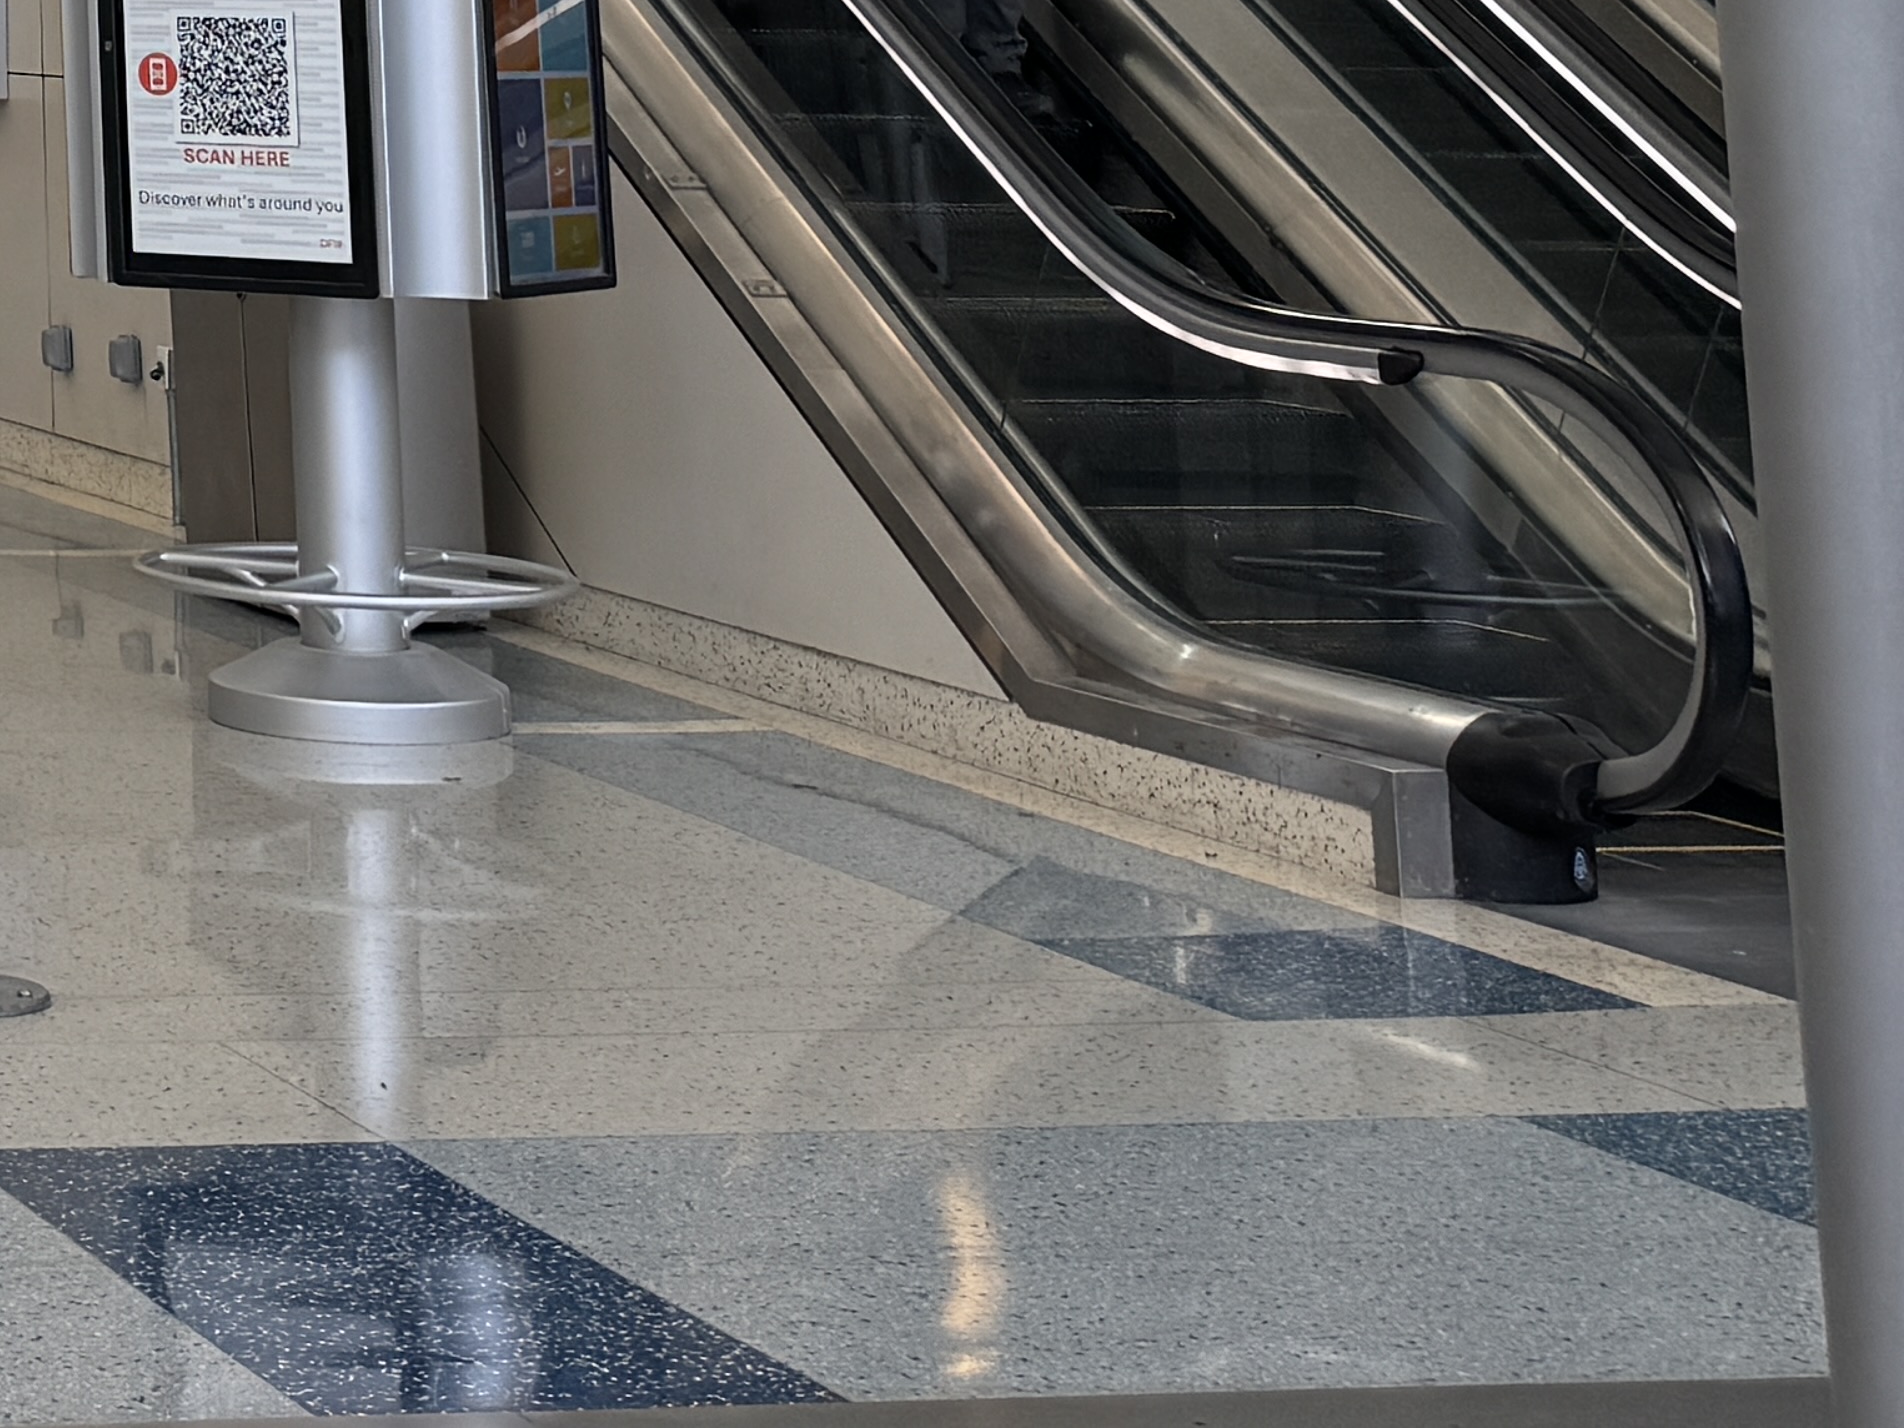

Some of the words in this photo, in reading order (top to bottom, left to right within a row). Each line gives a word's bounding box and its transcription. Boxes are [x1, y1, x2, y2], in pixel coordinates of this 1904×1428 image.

[183, 147, 235, 165] SCAN
[241, 149, 290, 168] HERE
[138, 190, 202, 207] Discover
[205, 193, 255, 209] what's
[258, 196, 312, 212] around
[316, 200, 344, 215] you
